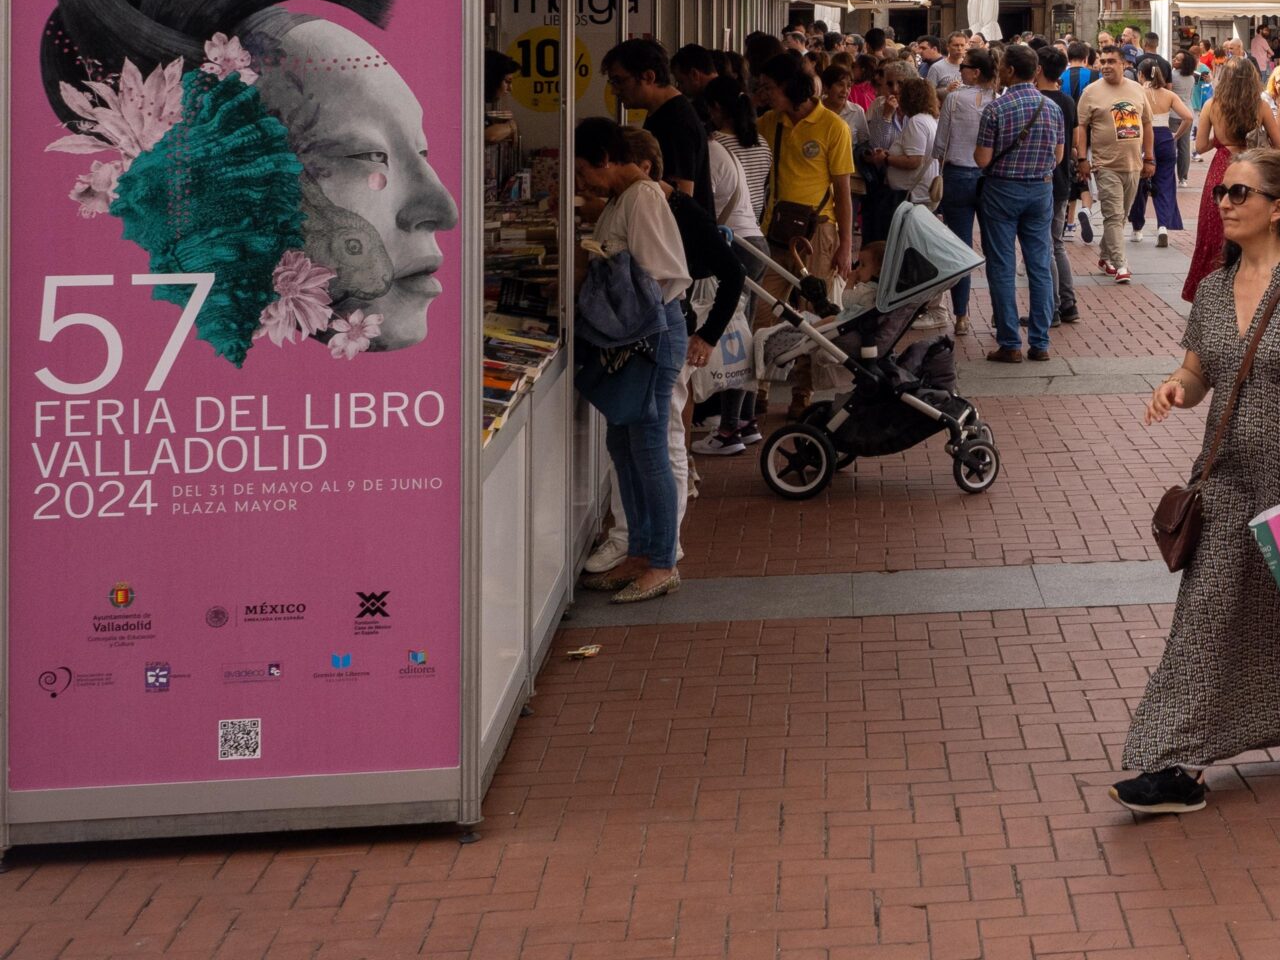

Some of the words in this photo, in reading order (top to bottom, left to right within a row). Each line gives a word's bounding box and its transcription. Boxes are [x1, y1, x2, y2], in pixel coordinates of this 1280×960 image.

[34, 272, 215, 395] 57
[711, 370, 723, 380] Yo
[34, 398, 176, 438] FERIA
[196, 395, 286, 433] DEL
[305, 390, 445, 429] LIBRO
[32, 434, 327, 478] VALLADOLID
[172, 485, 202, 498] DEL
[209, 484, 225, 497] 31
[233, 483, 254, 496] DE
[262, 481, 313, 495] MAYO
[320, 480, 340, 493] AL
[347, 480, 354, 492] 9
[363, 479, 383, 491] DE
[390, 477, 443, 491] JUNIO
[33, 480, 158, 520] 2024
[172, 501, 227, 515] PLAZA
[234, 499, 298, 513] MAYOR
[245, 602, 306, 615] MÉXICO
[93, 613, 141, 621] Ayuntamiento
[93, 620, 152, 632] Valladolid
[399, 663, 436, 674] editores
